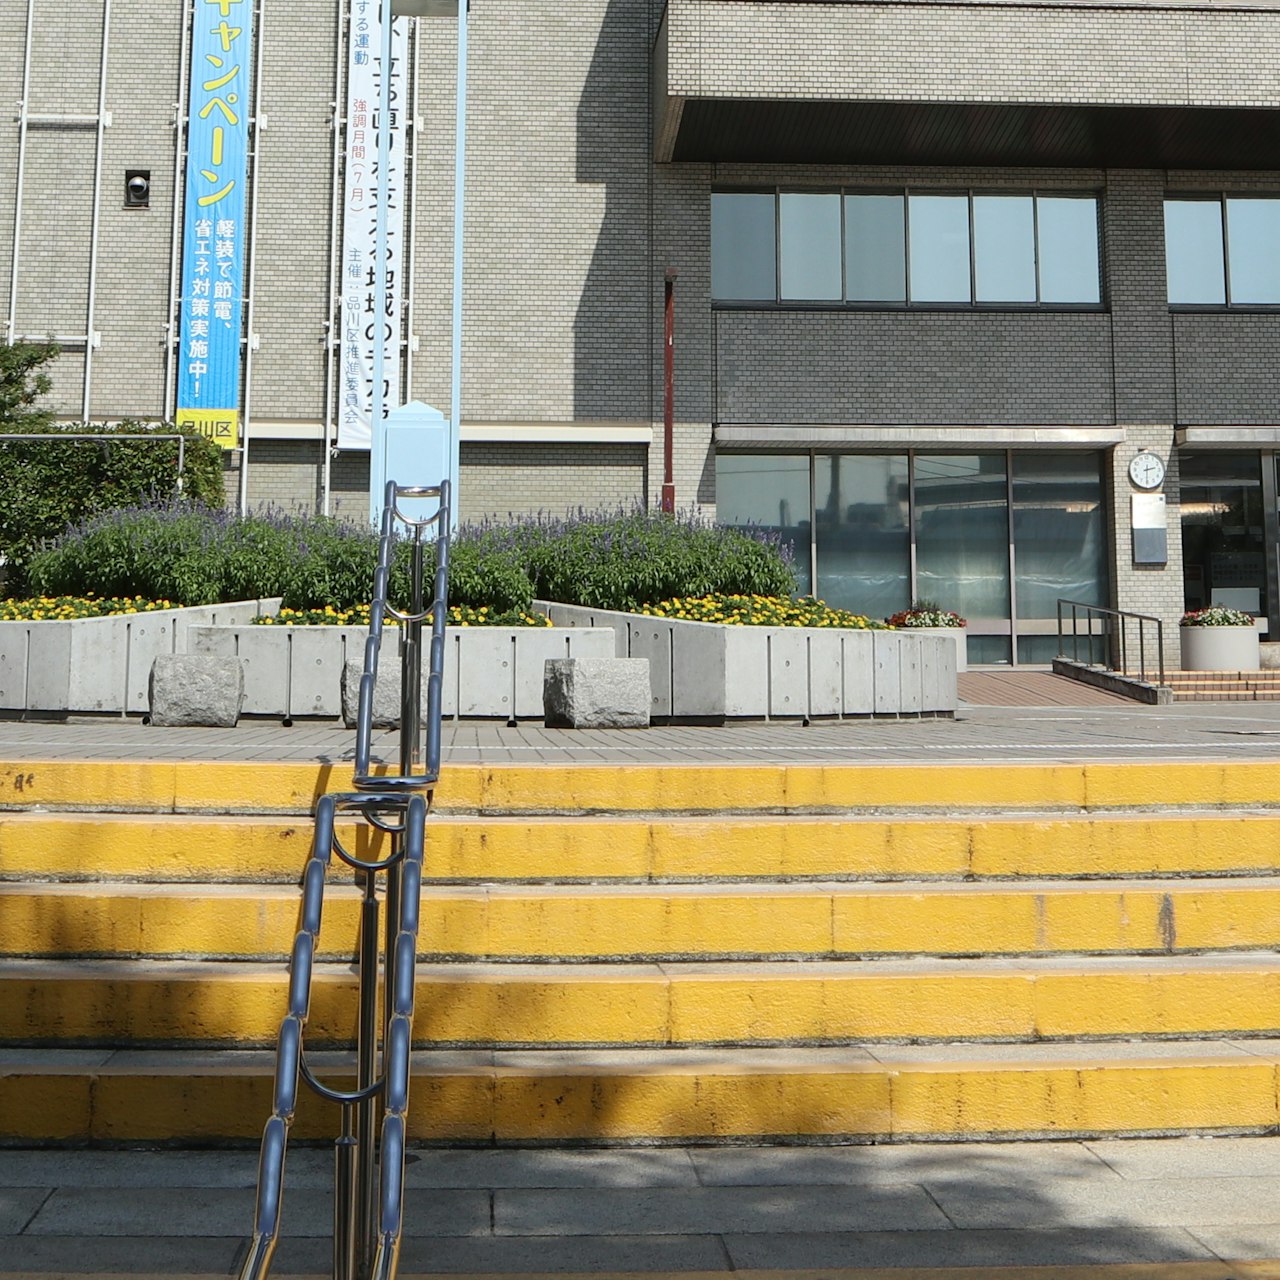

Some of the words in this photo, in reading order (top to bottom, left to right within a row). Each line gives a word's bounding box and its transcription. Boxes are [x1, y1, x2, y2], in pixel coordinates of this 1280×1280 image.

[189, 219, 213, 398] 省エネ対策実施中！
[213, 219, 235, 329] 軽装で節電、
